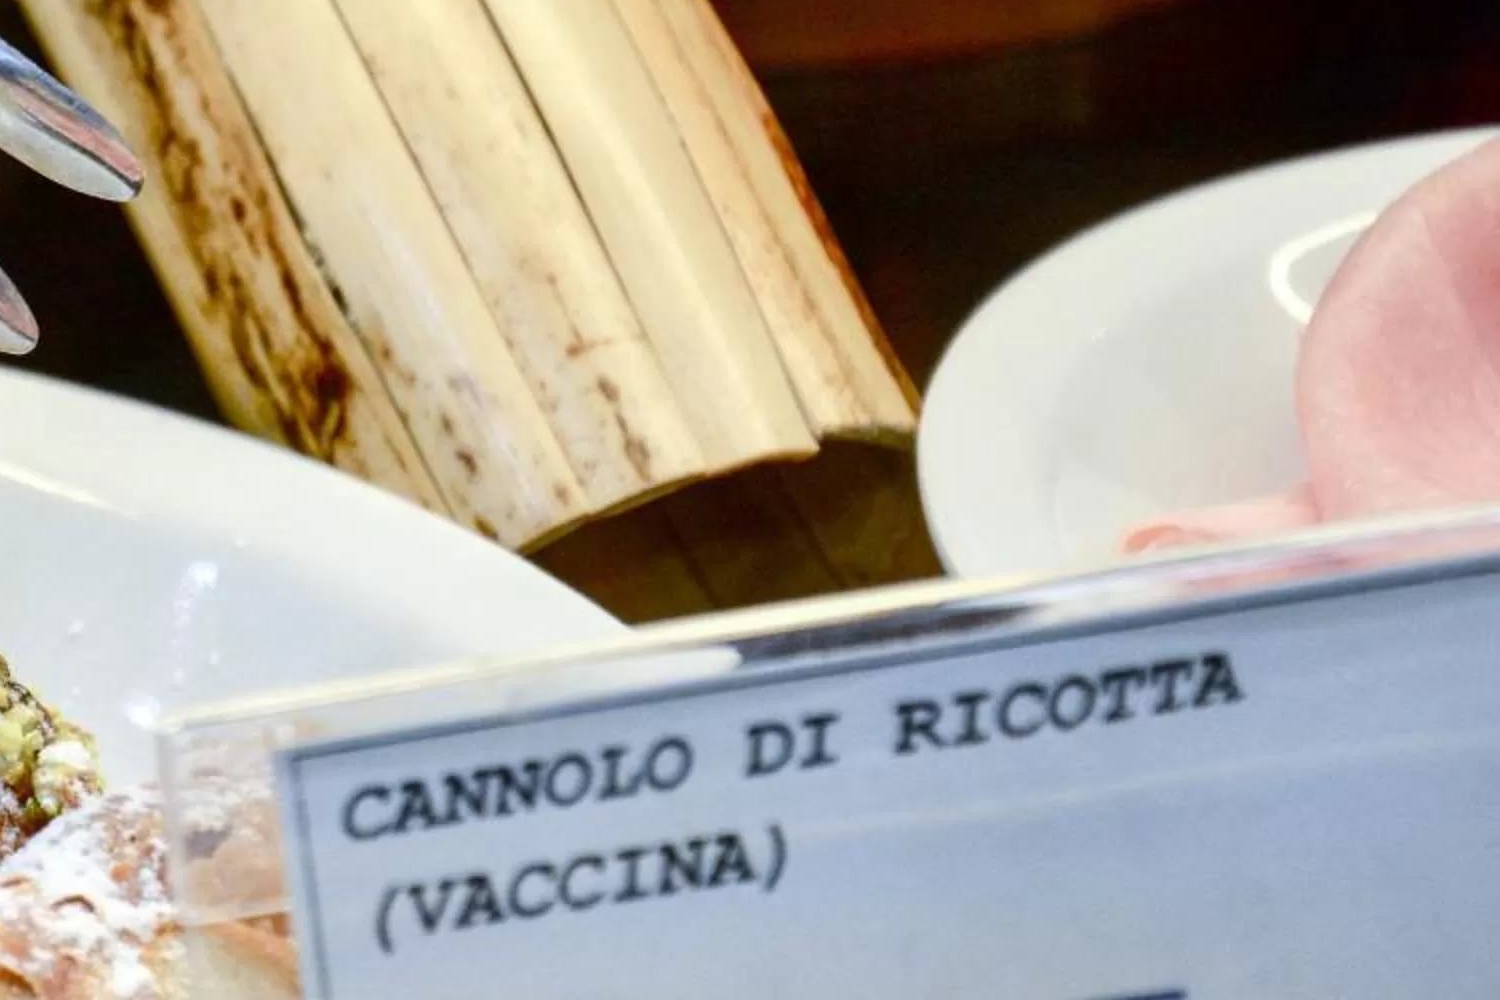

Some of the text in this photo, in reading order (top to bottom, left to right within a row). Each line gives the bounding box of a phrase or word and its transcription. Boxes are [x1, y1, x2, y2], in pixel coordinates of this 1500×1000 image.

[341, 650, 1244, 842] CANNOLO DI RICOTTA
[376, 822, 791, 954] (VACCINA)
